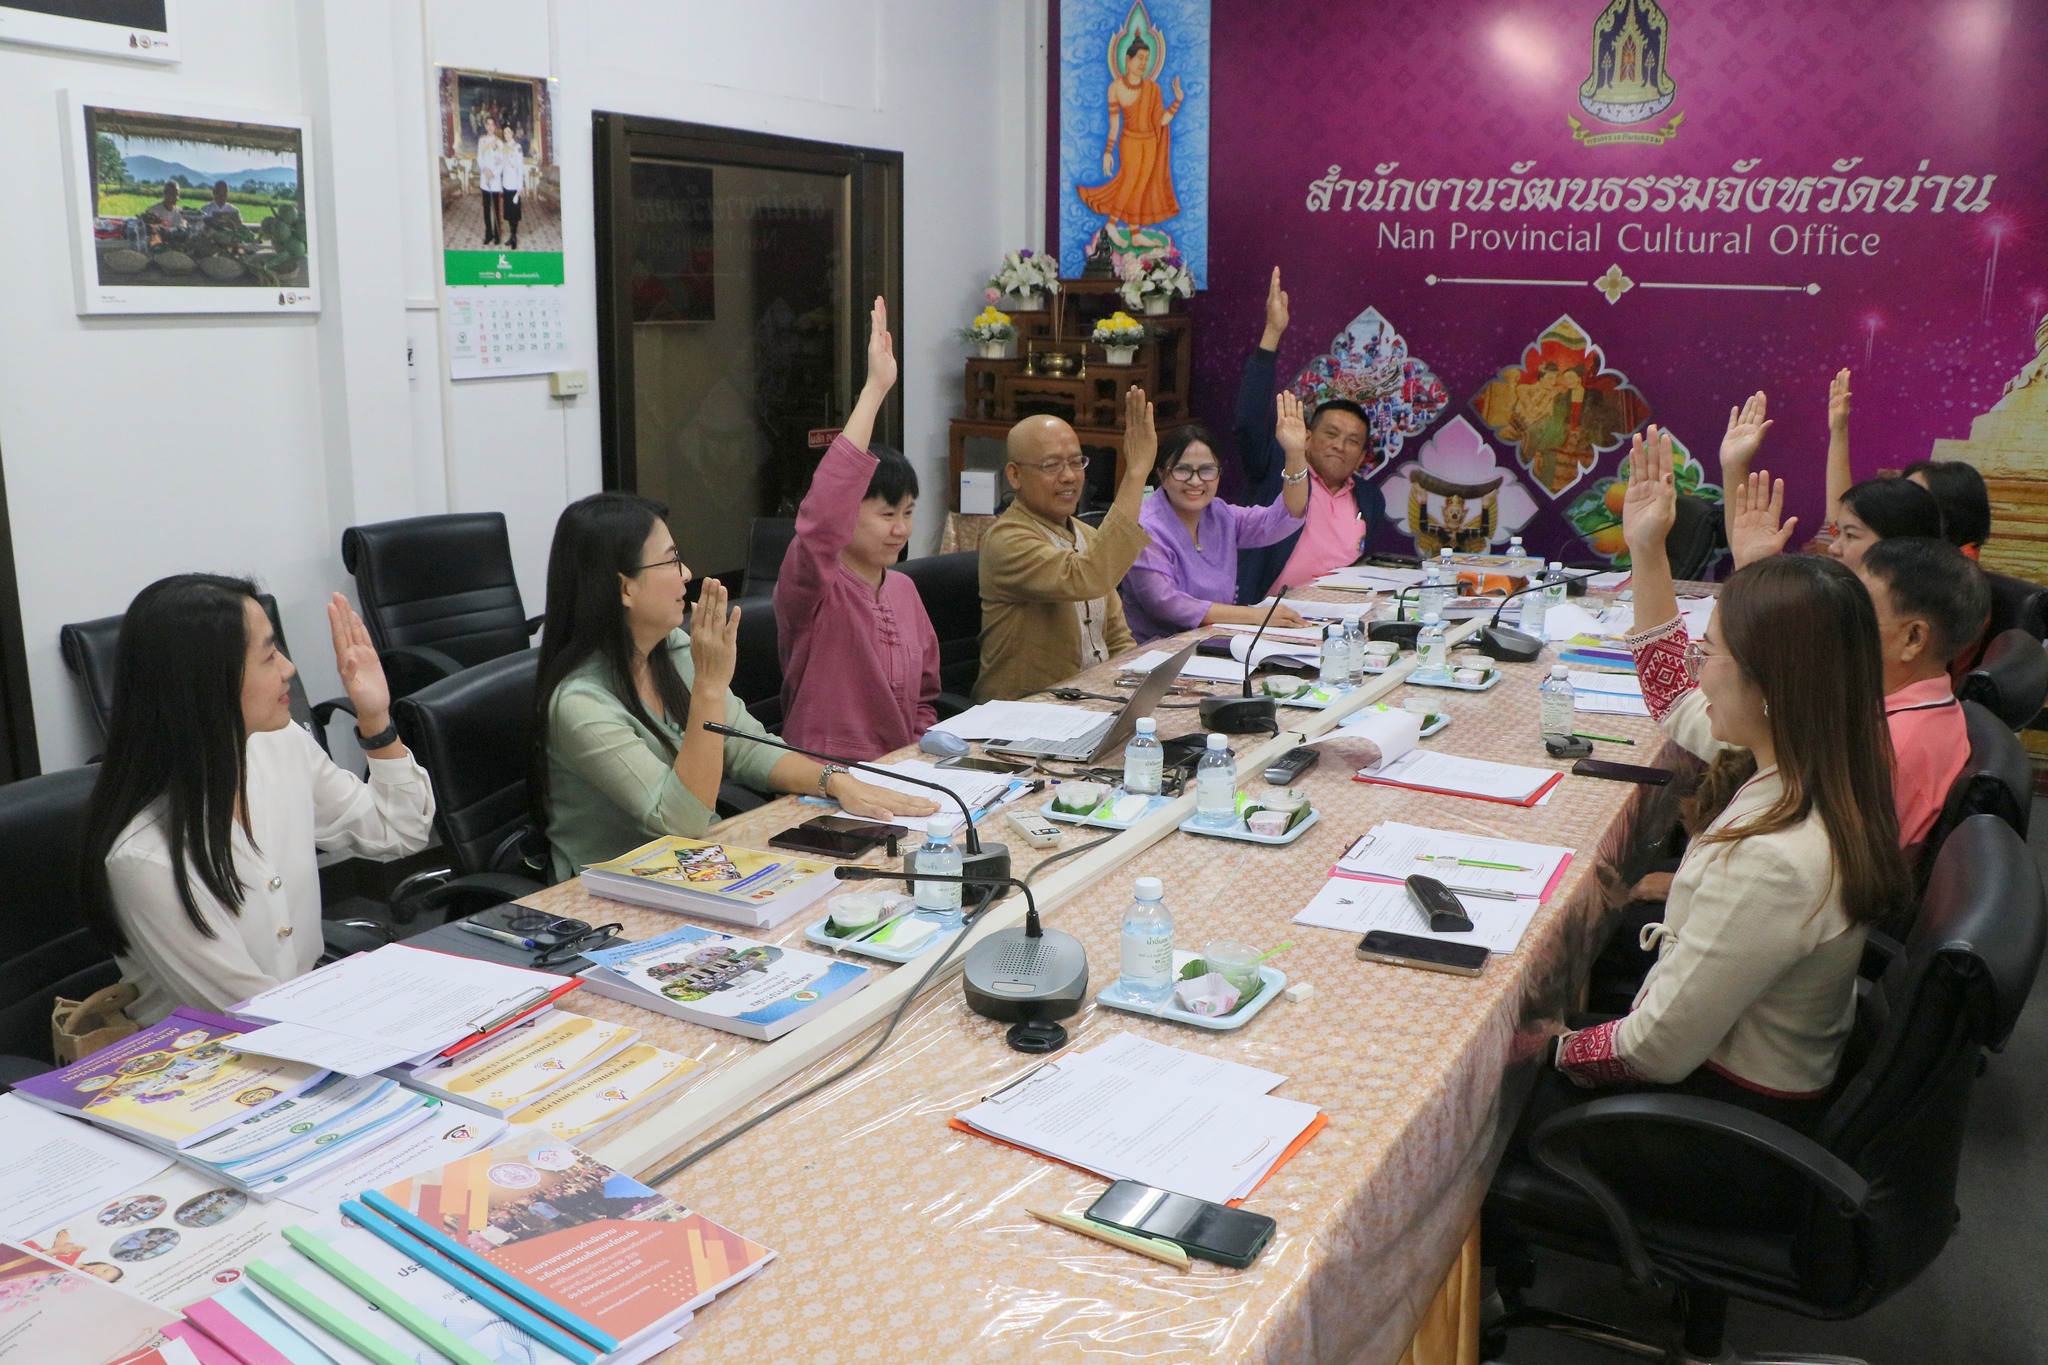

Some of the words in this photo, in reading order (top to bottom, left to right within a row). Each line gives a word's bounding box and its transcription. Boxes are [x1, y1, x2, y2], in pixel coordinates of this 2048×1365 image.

[1306, 157, 1998, 213] สำนักงานวัฒนธรรมจังหวัดน่าน
[1377, 221, 1435, 249] Nan
[1450, 221, 1602, 251] Provincial
[1618, 222, 1752, 253] Cultural
[1769, 223, 1881, 256] Office
